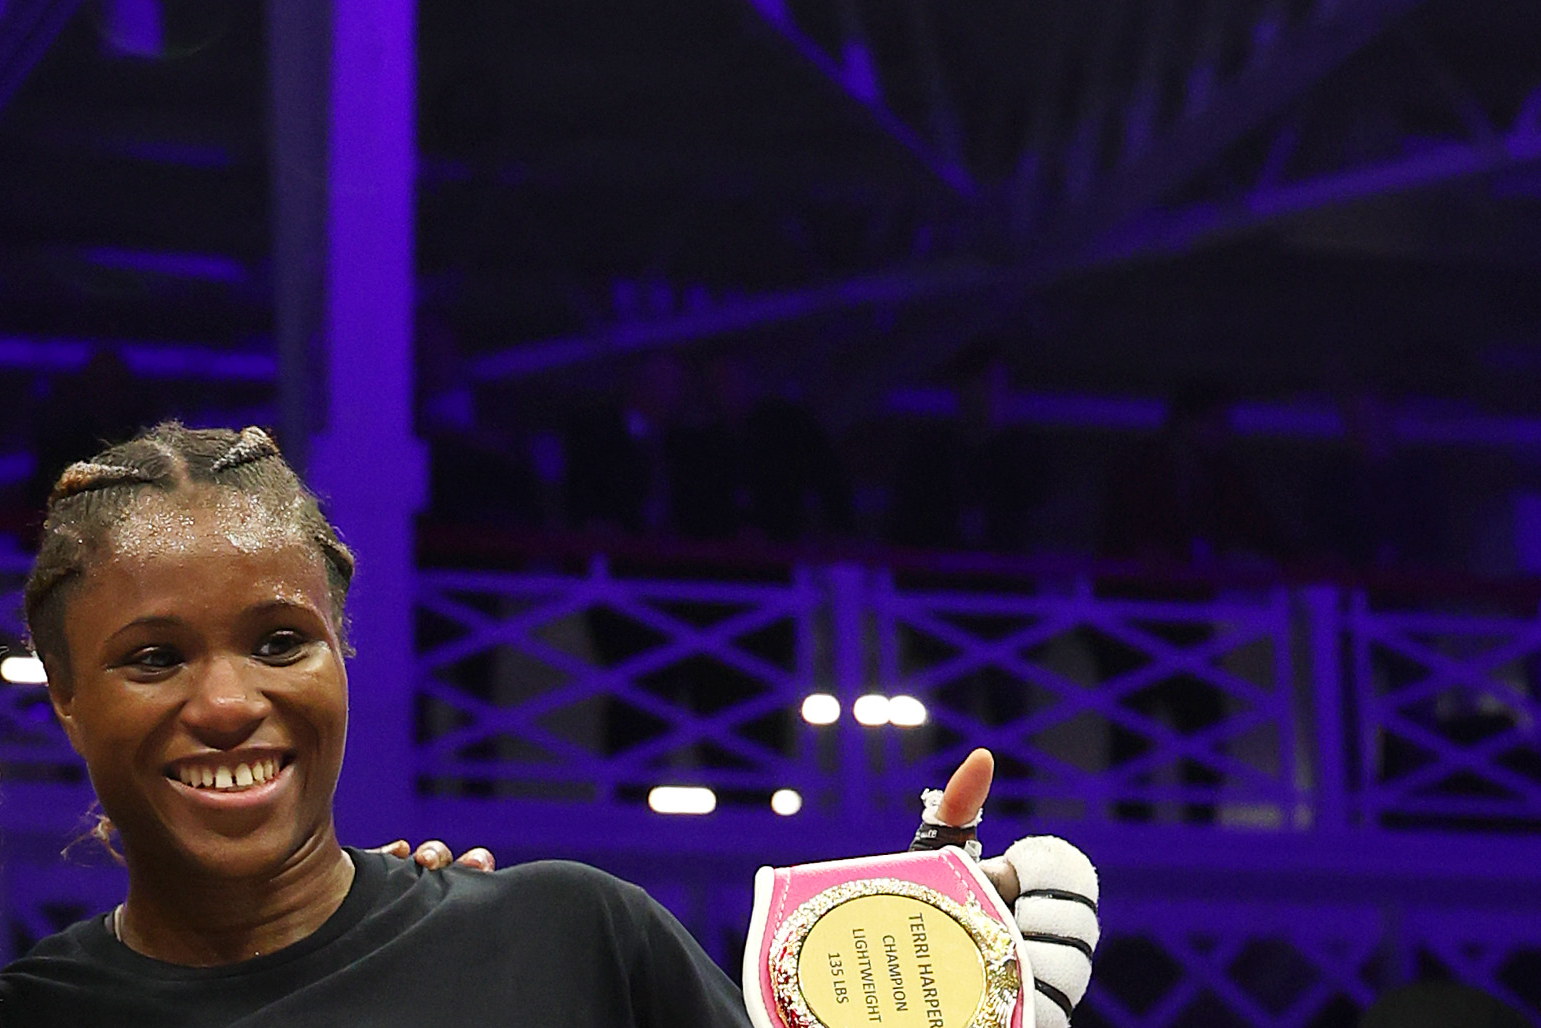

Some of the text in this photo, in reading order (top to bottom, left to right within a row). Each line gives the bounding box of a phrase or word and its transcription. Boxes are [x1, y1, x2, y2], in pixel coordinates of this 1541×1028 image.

[828, 952, 849, 1004] 135 LBS
[852, 928, 882, 1023] LIGHTWEIGHT
[882, 935, 908, 1012] CHAMPION
[908, 912, 944, 1028] TERRI HARPER
